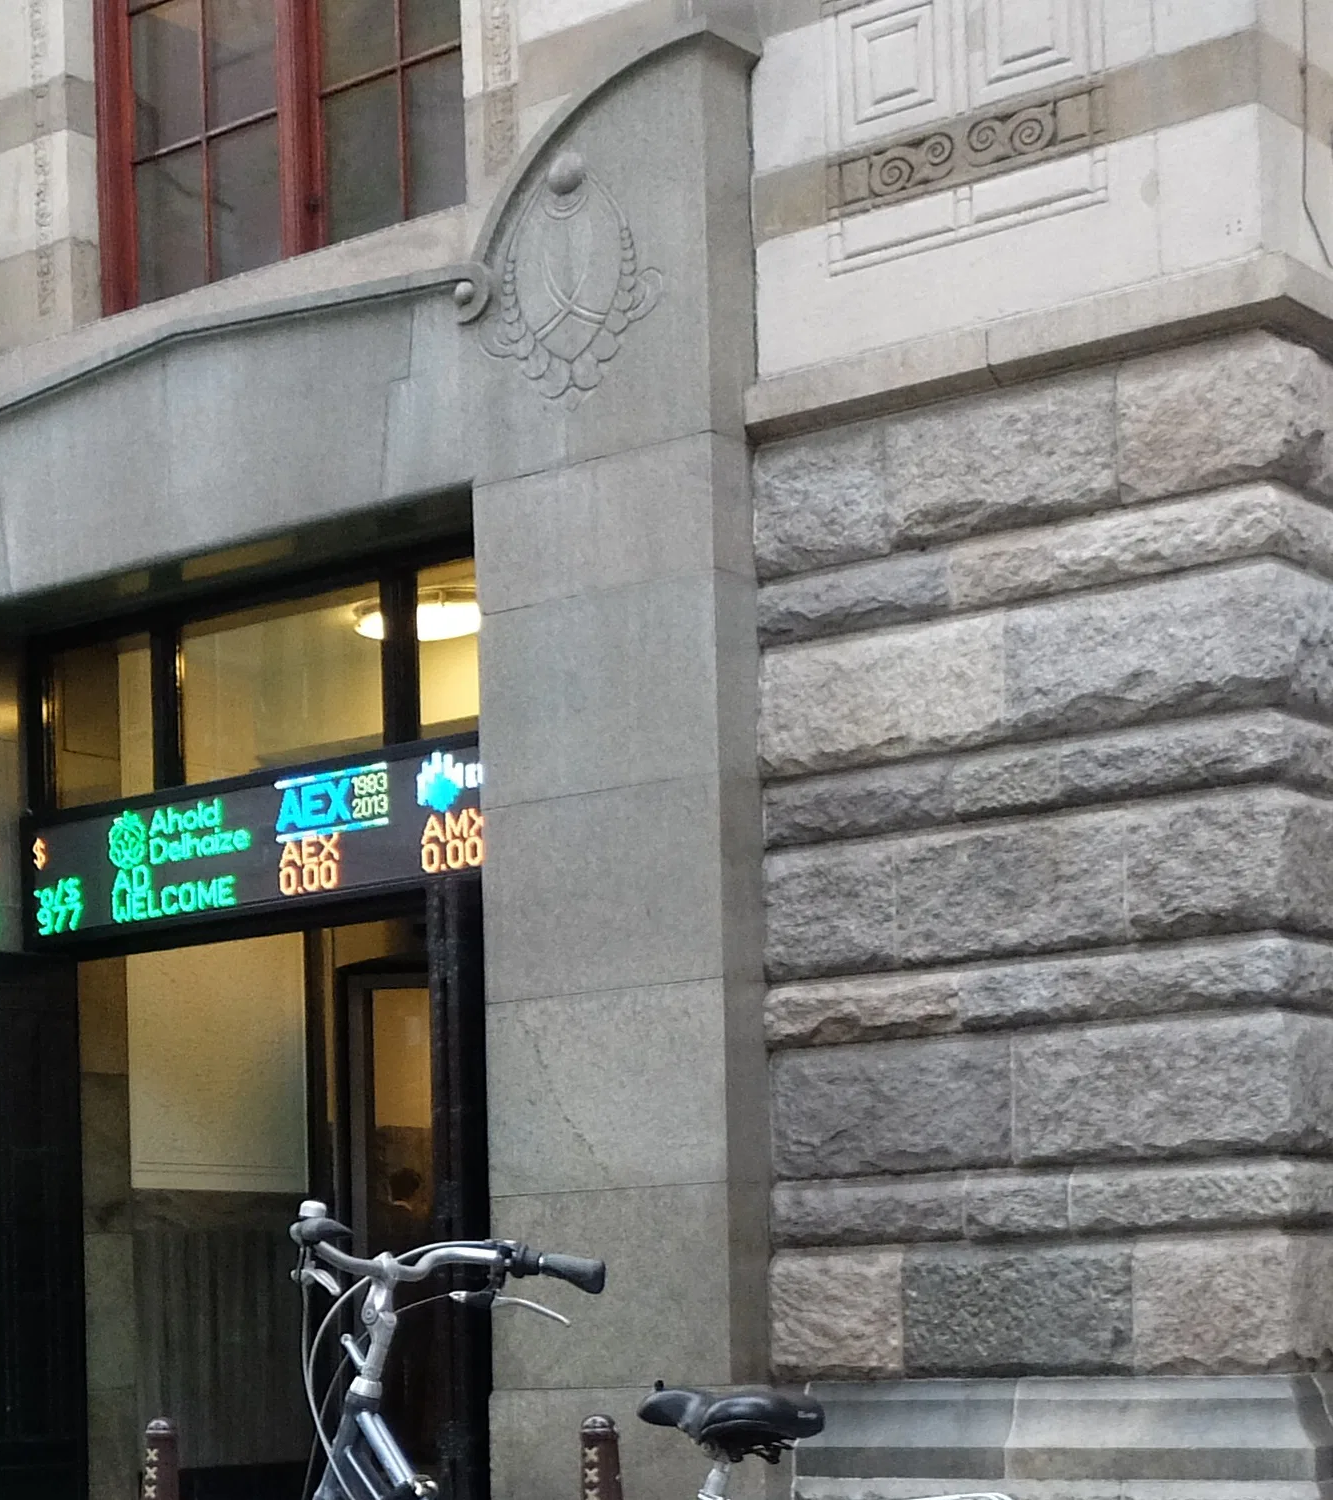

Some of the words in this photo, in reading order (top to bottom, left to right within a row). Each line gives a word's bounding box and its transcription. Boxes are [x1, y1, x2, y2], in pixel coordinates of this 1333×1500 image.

[148, 798, 224, 838] Ahold
[275, 778, 352, 832] AEX
[351, 793, 389, 821] 2013
[421, 808, 485, 845] AMX
[149, 826, 252, 866] Delhaize
[279, 832, 341, 869] AEX
[421, 836, 486, 874] 0.00
[114, 865, 152, 895] AD
[279, 860, 340, 896] 0.00
[112, 875, 238, 923] WELCOME
